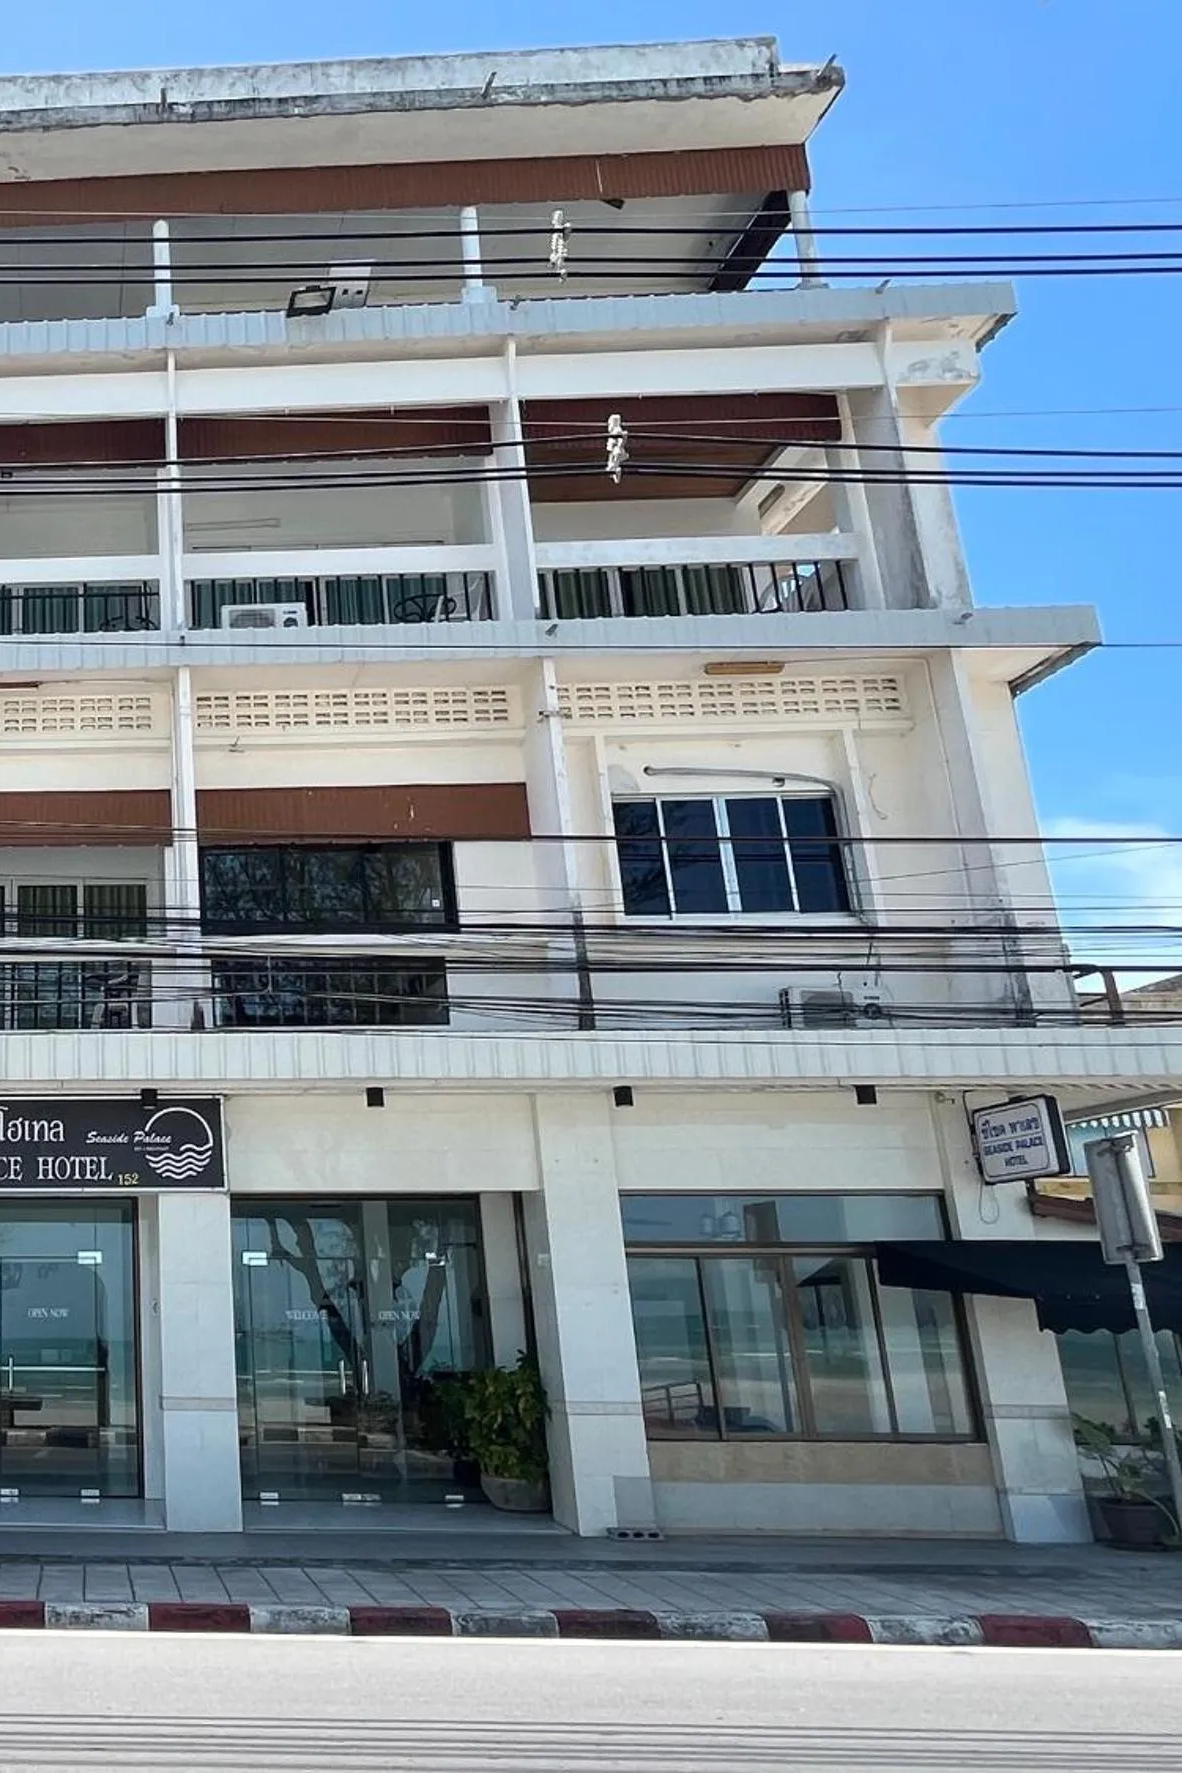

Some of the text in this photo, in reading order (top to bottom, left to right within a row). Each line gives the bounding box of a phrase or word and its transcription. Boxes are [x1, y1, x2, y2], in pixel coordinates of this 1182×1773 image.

[86, 1130, 172, 1144] Seaside Palace
[36, 1156, 114, 1181] HOTEL
[118, 1173, 140, 1186] 152
